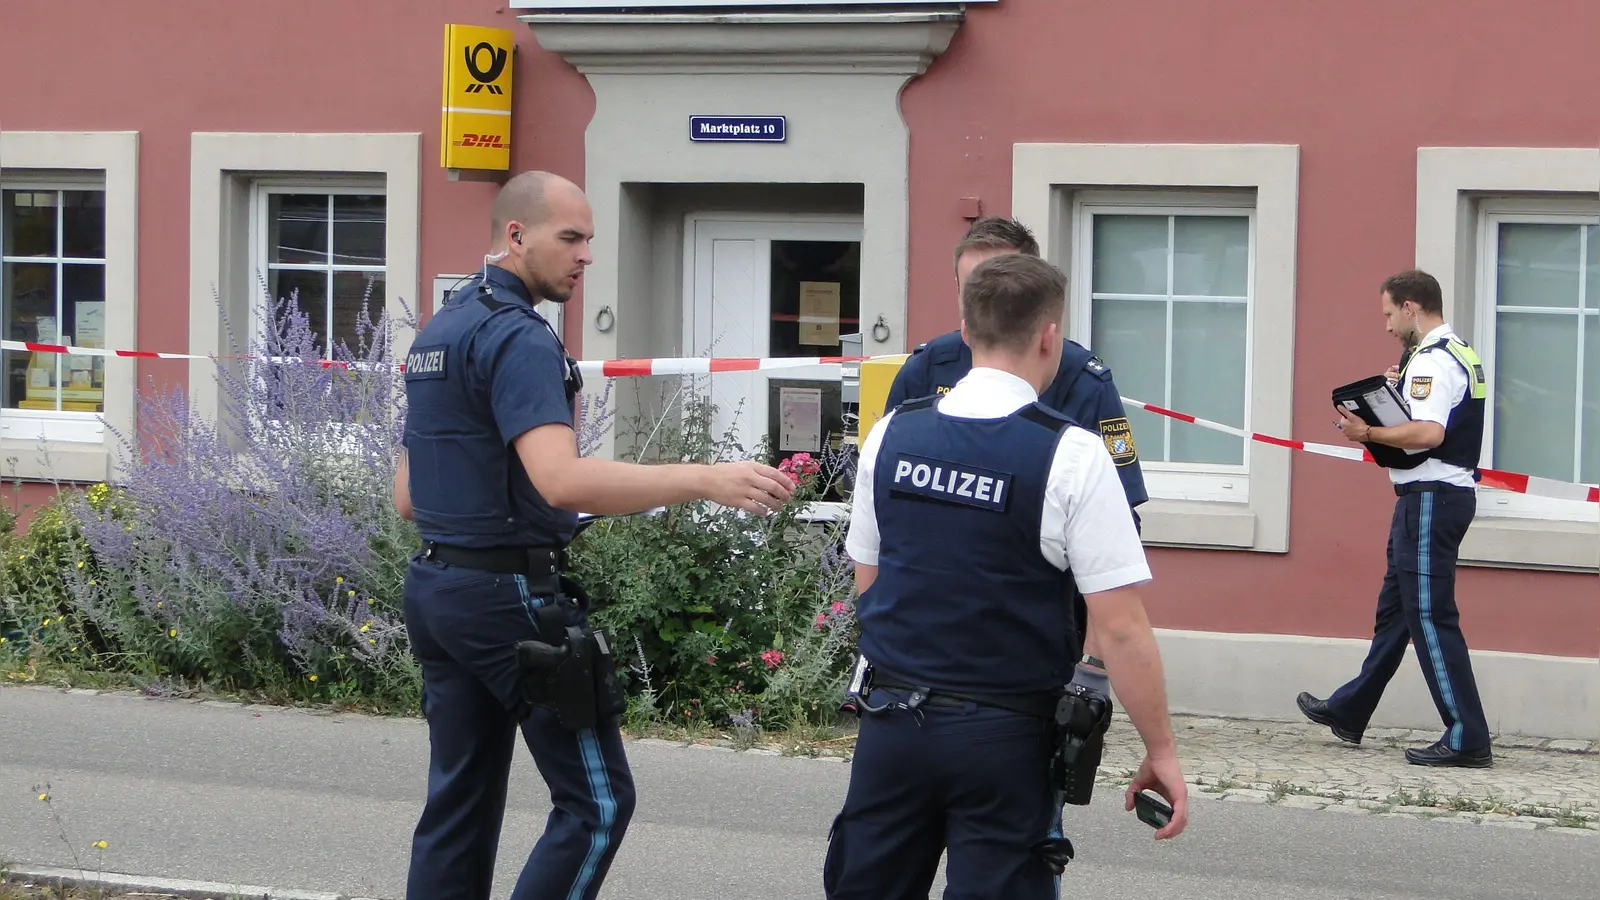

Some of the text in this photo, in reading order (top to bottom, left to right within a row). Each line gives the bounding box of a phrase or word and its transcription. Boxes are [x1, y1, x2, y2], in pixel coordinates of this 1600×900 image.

[700, 123, 775, 135] Marktplatz 10
[461, 133, 503, 149] DHL
[406, 350, 445, 374] POLIZEI
[894, 460, 1004, 504] POLIZEI
